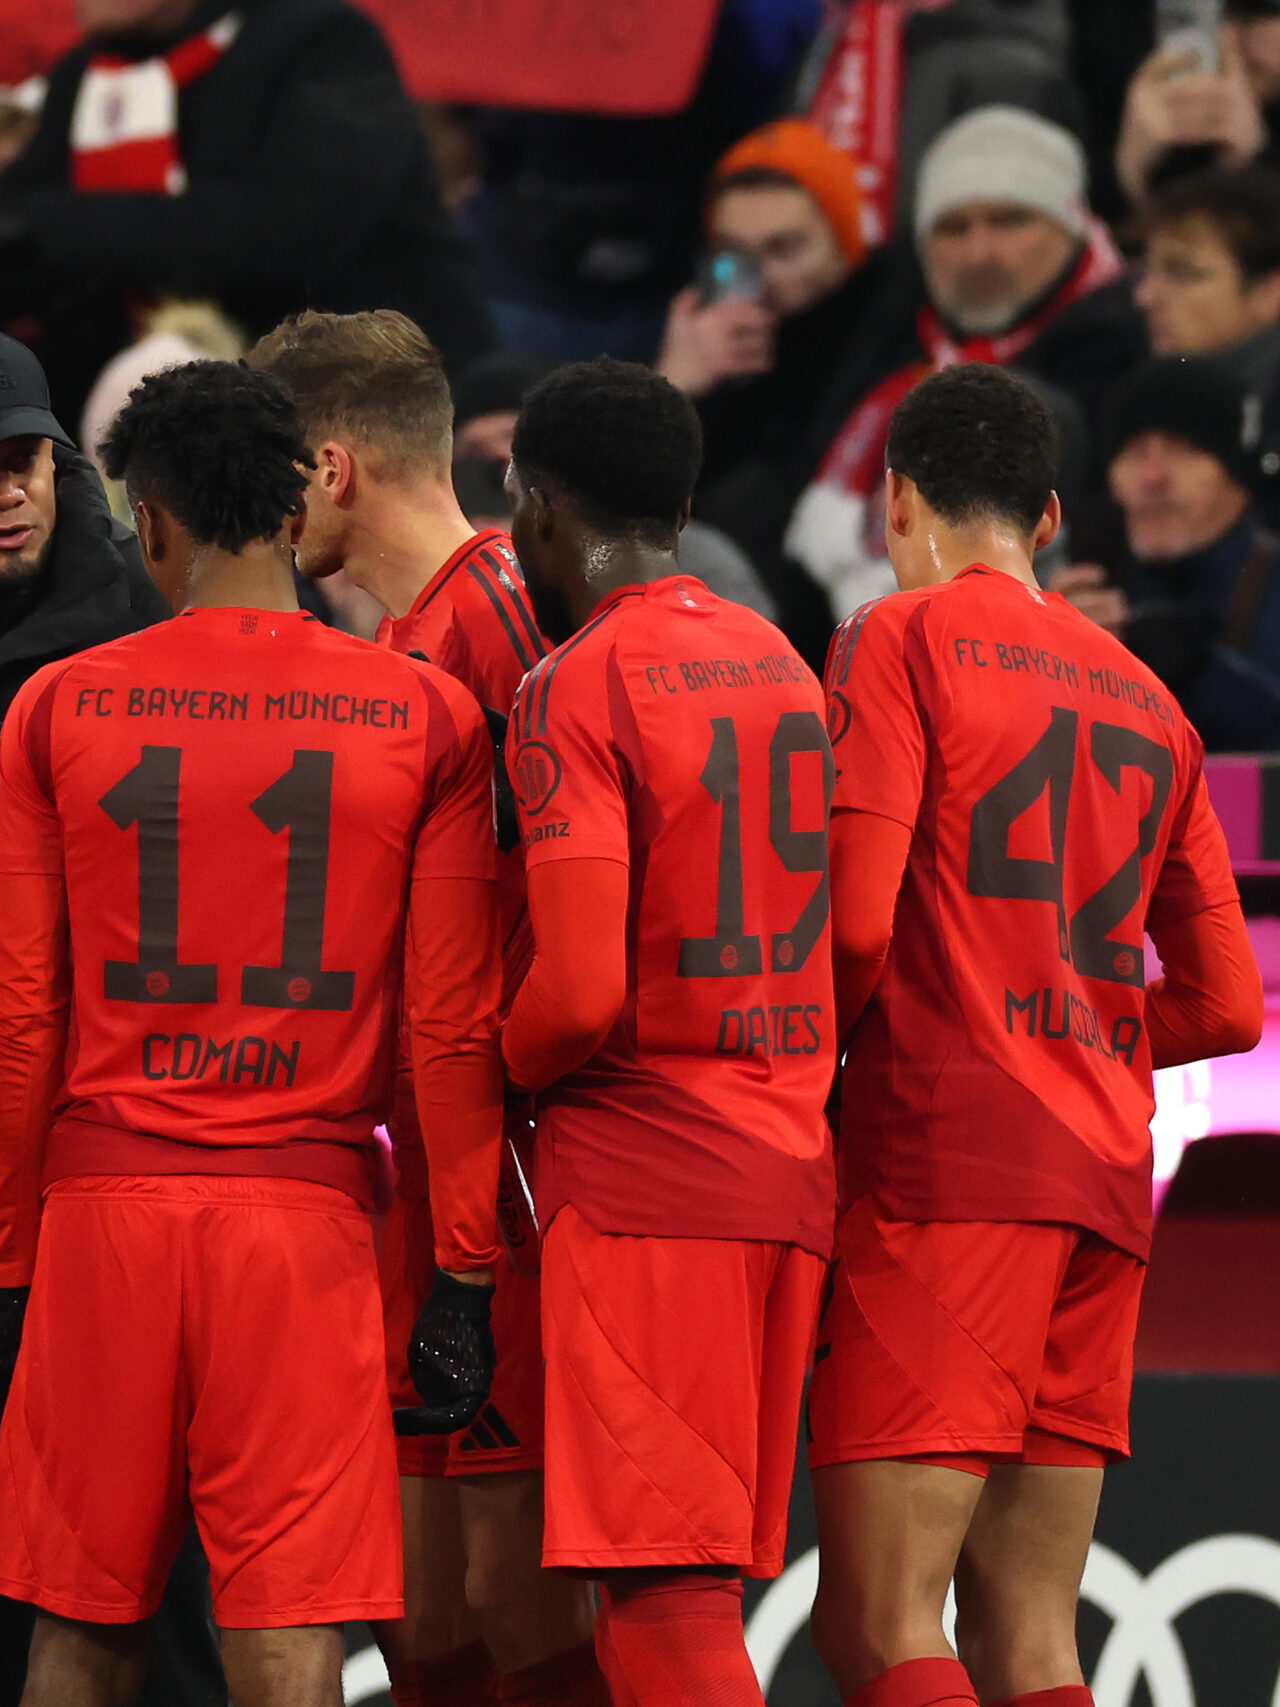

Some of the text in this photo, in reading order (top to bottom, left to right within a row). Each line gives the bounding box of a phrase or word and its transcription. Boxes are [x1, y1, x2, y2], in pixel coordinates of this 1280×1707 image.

[646, 665, 677, 694] FC
[679, 659, 754, 691] BAYERN
[954, 638, 988, 666] FC
[995, 642, 1080, 689] BAYERN
[75, 687, 409, 730] FC BAYERN MÜNCHEN
[677, 711, 835, 978] 19
[967, 705, 1173, 989] 42
[97, 744, 356, 1012] 11
[714, 1003, 823, 1057] DAIES
[142, 1032, 301, 1087] COMAN
